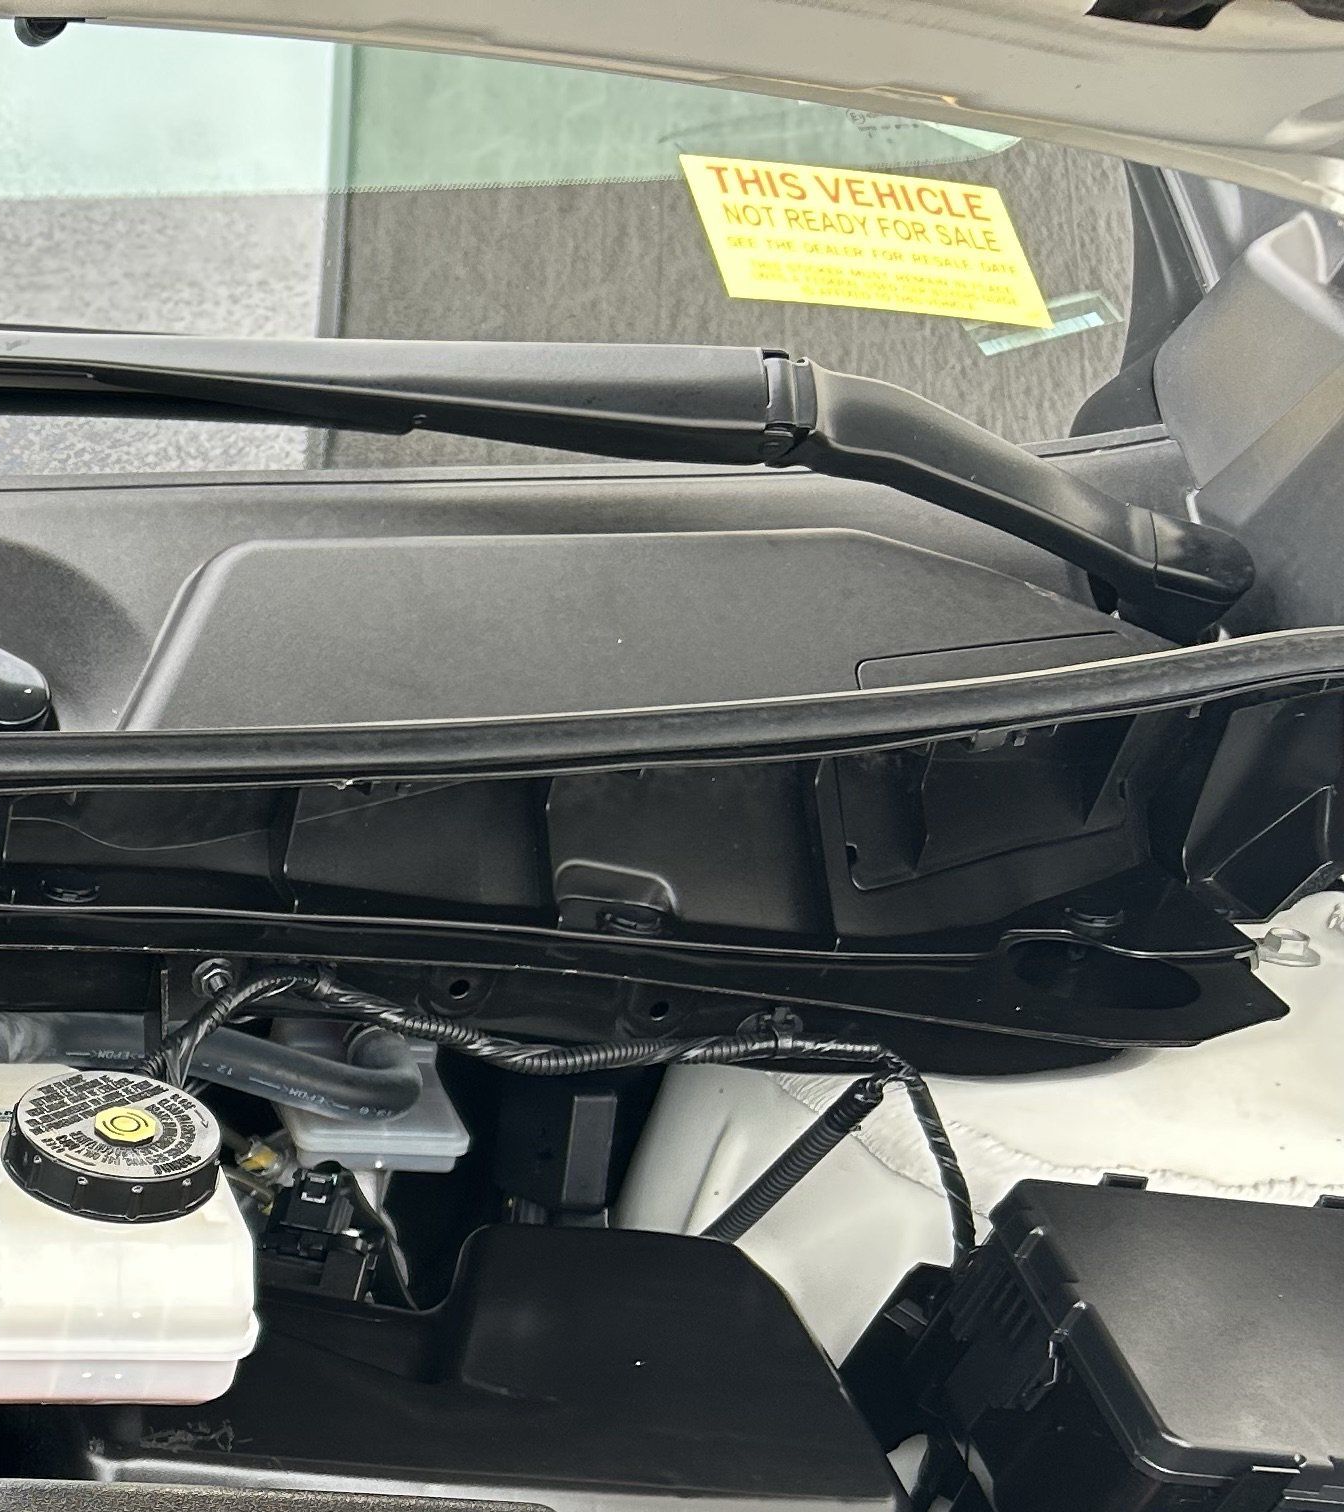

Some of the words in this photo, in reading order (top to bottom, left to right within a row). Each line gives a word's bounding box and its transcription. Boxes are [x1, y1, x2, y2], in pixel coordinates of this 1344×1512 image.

[706, 166, 807, 200] THIS
[815, 175, 991, 221] VEHICLE
[723, 203, 774, 227] NOT
[784, 208, 868, 236] READY
[877, 217, 930, 243] FOR
[936, 224, 1000, 252] SALE
[804, 241, 862, 257] DEALER
